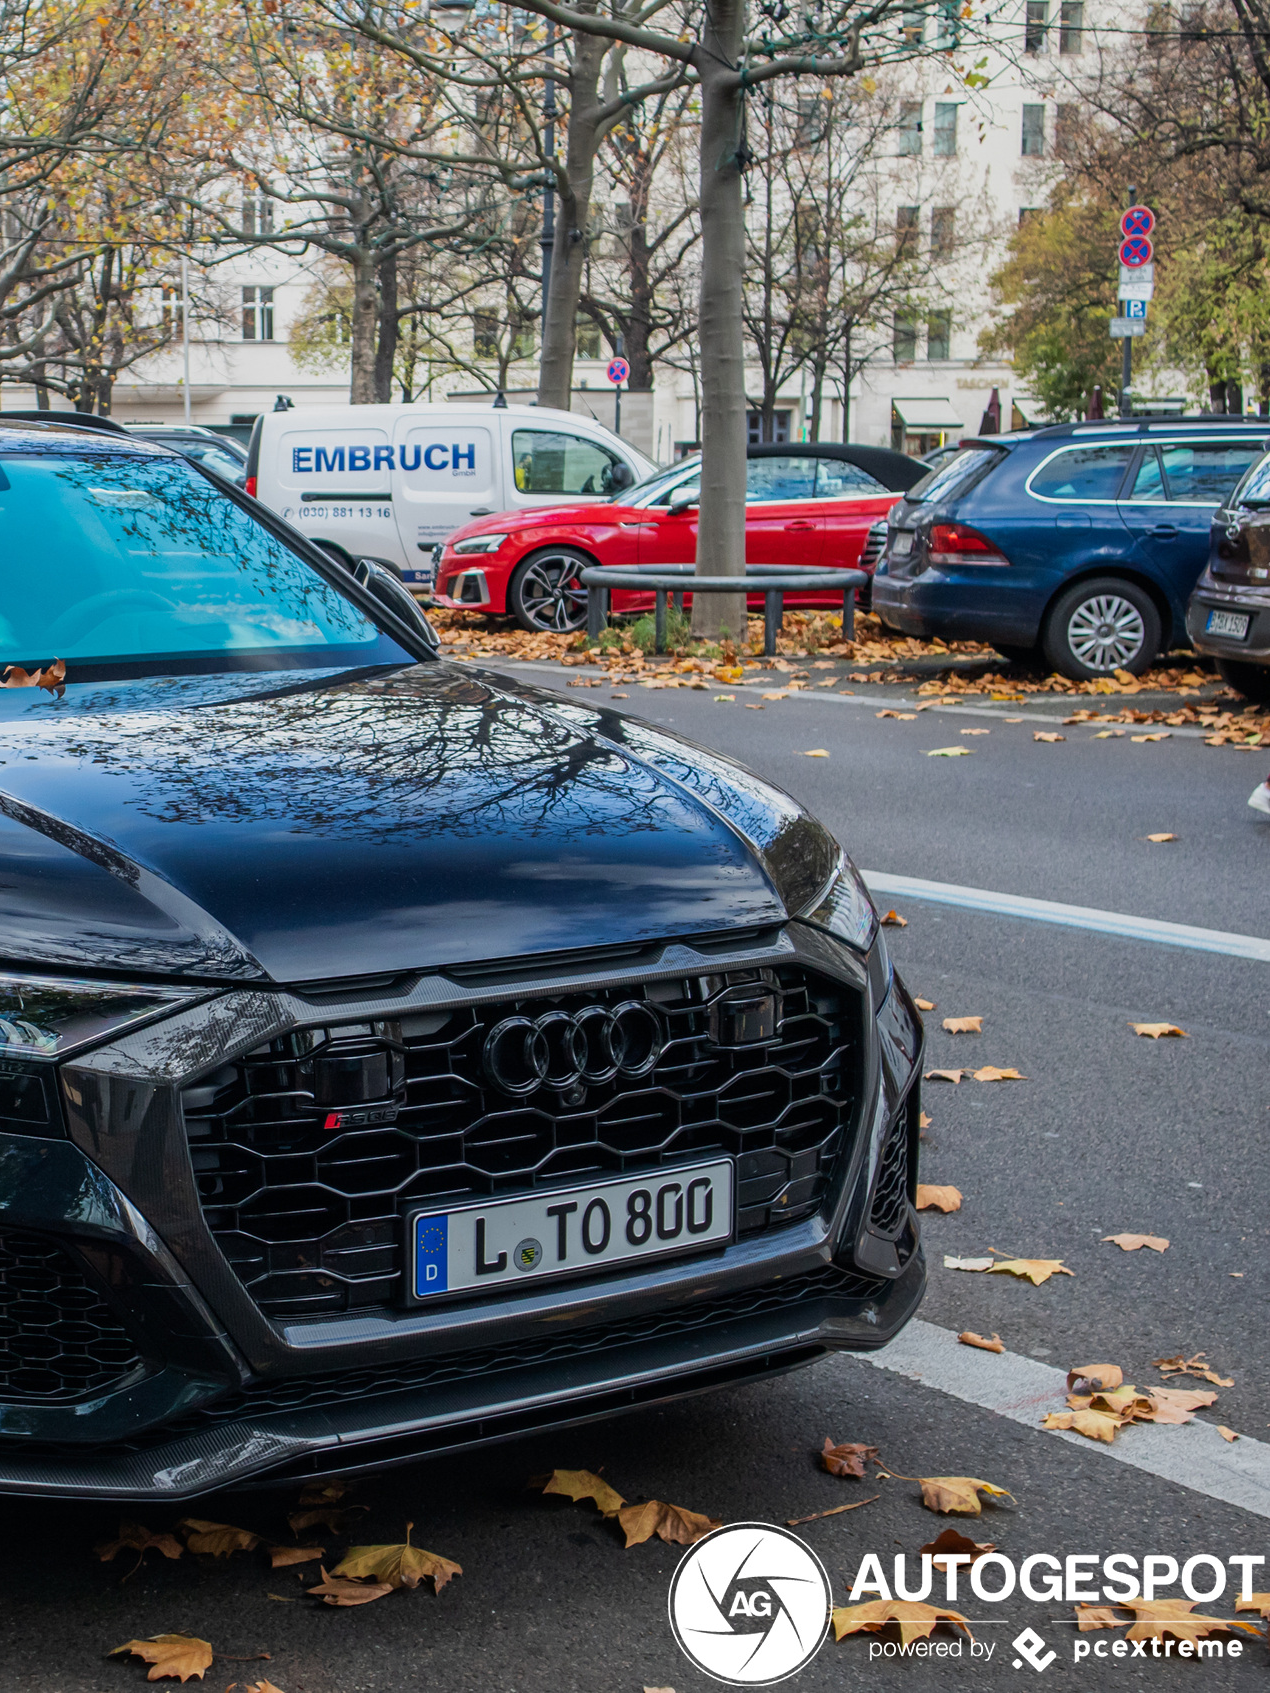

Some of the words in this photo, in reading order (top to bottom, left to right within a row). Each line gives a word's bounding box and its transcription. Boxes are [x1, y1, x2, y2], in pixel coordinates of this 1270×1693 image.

[292, 443, 476, 473] EMBRUCH
[298, 507, 329, 519] (030)
[332, 507, 353, 518] 881
[360, 507, 372, 518] 13
[377, 507, 390, 518] 16
[475, 1216, 508, 1276] L
[547, 1195, 611, 1261] TO
[626, 1176, 713, 1247] 800
[425, 1264, 438, 1281] D
